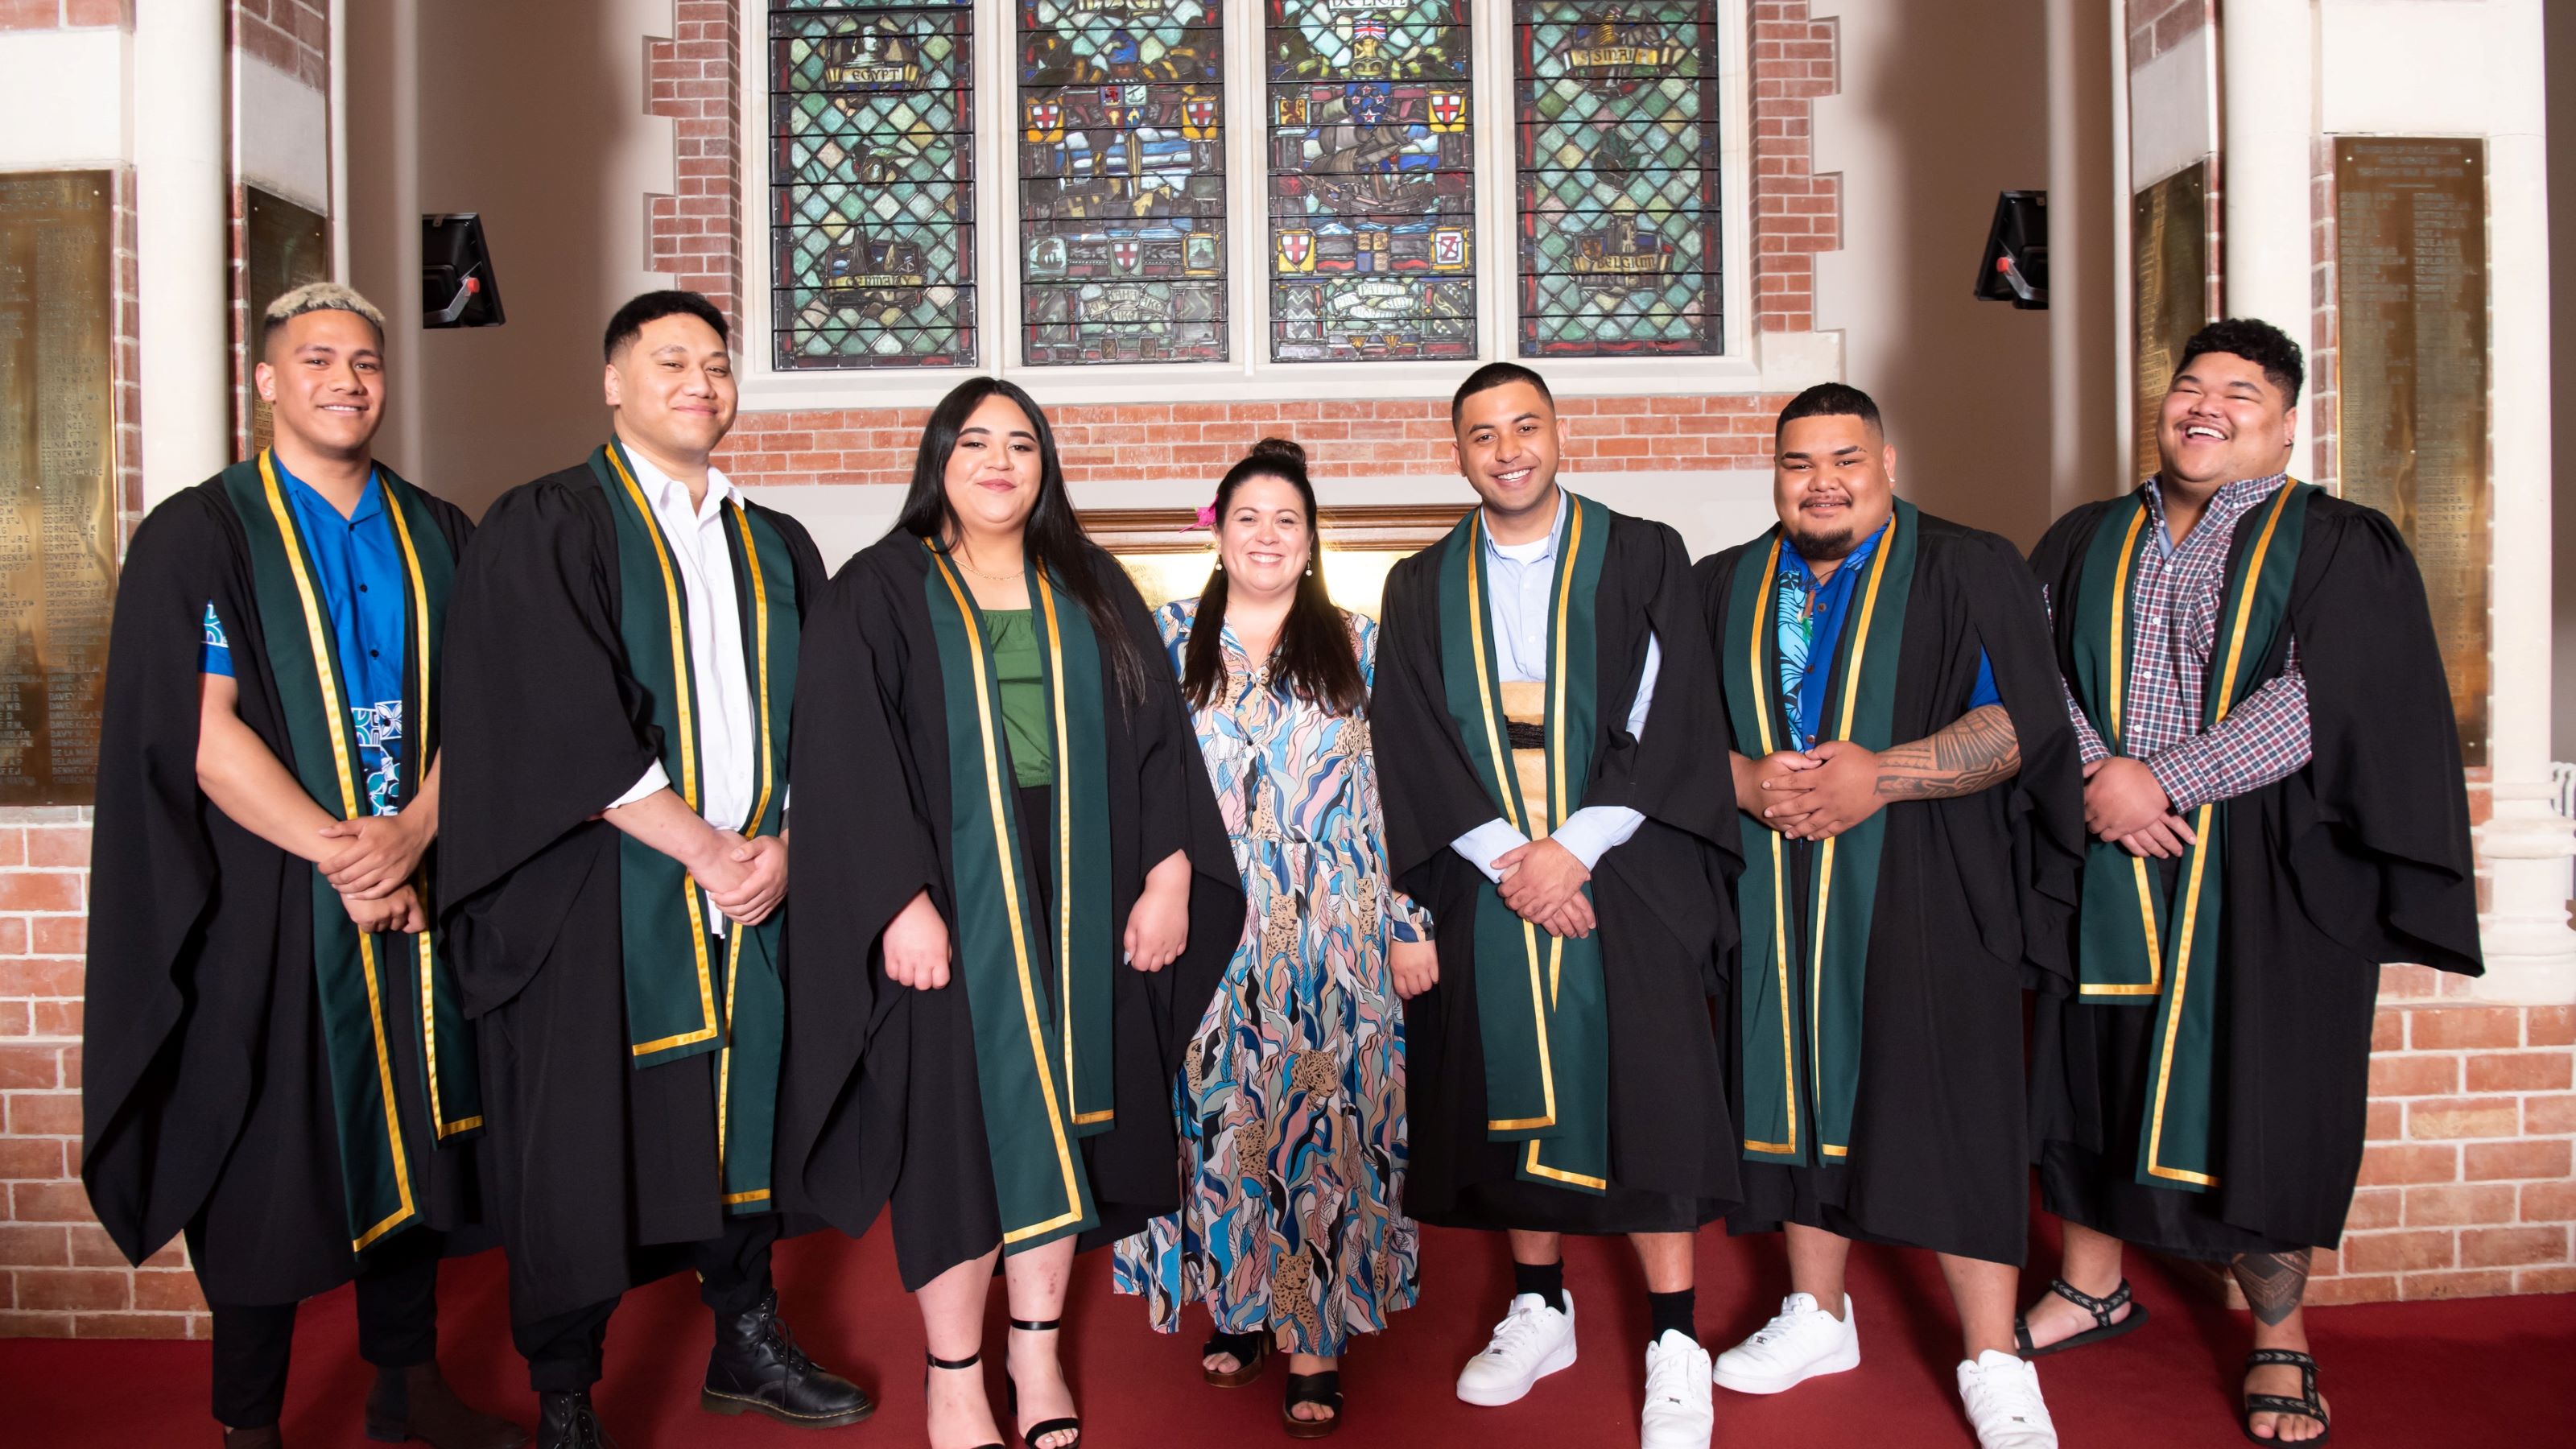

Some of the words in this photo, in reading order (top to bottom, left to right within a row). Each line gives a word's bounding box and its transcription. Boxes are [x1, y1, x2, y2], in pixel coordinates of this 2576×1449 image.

[1594, 49, 1633, 61] SINAI
[852, 69, 899, 80] EGYPT
[1597, 257, 1653, 268] BELGIUM
[846, 276, 910, 286] GERMANY
[43, 535, 79, 543] CORKILL
[44, 553, 86, 561] COVENTRY
[45, 562, 77, 570] COWLES
